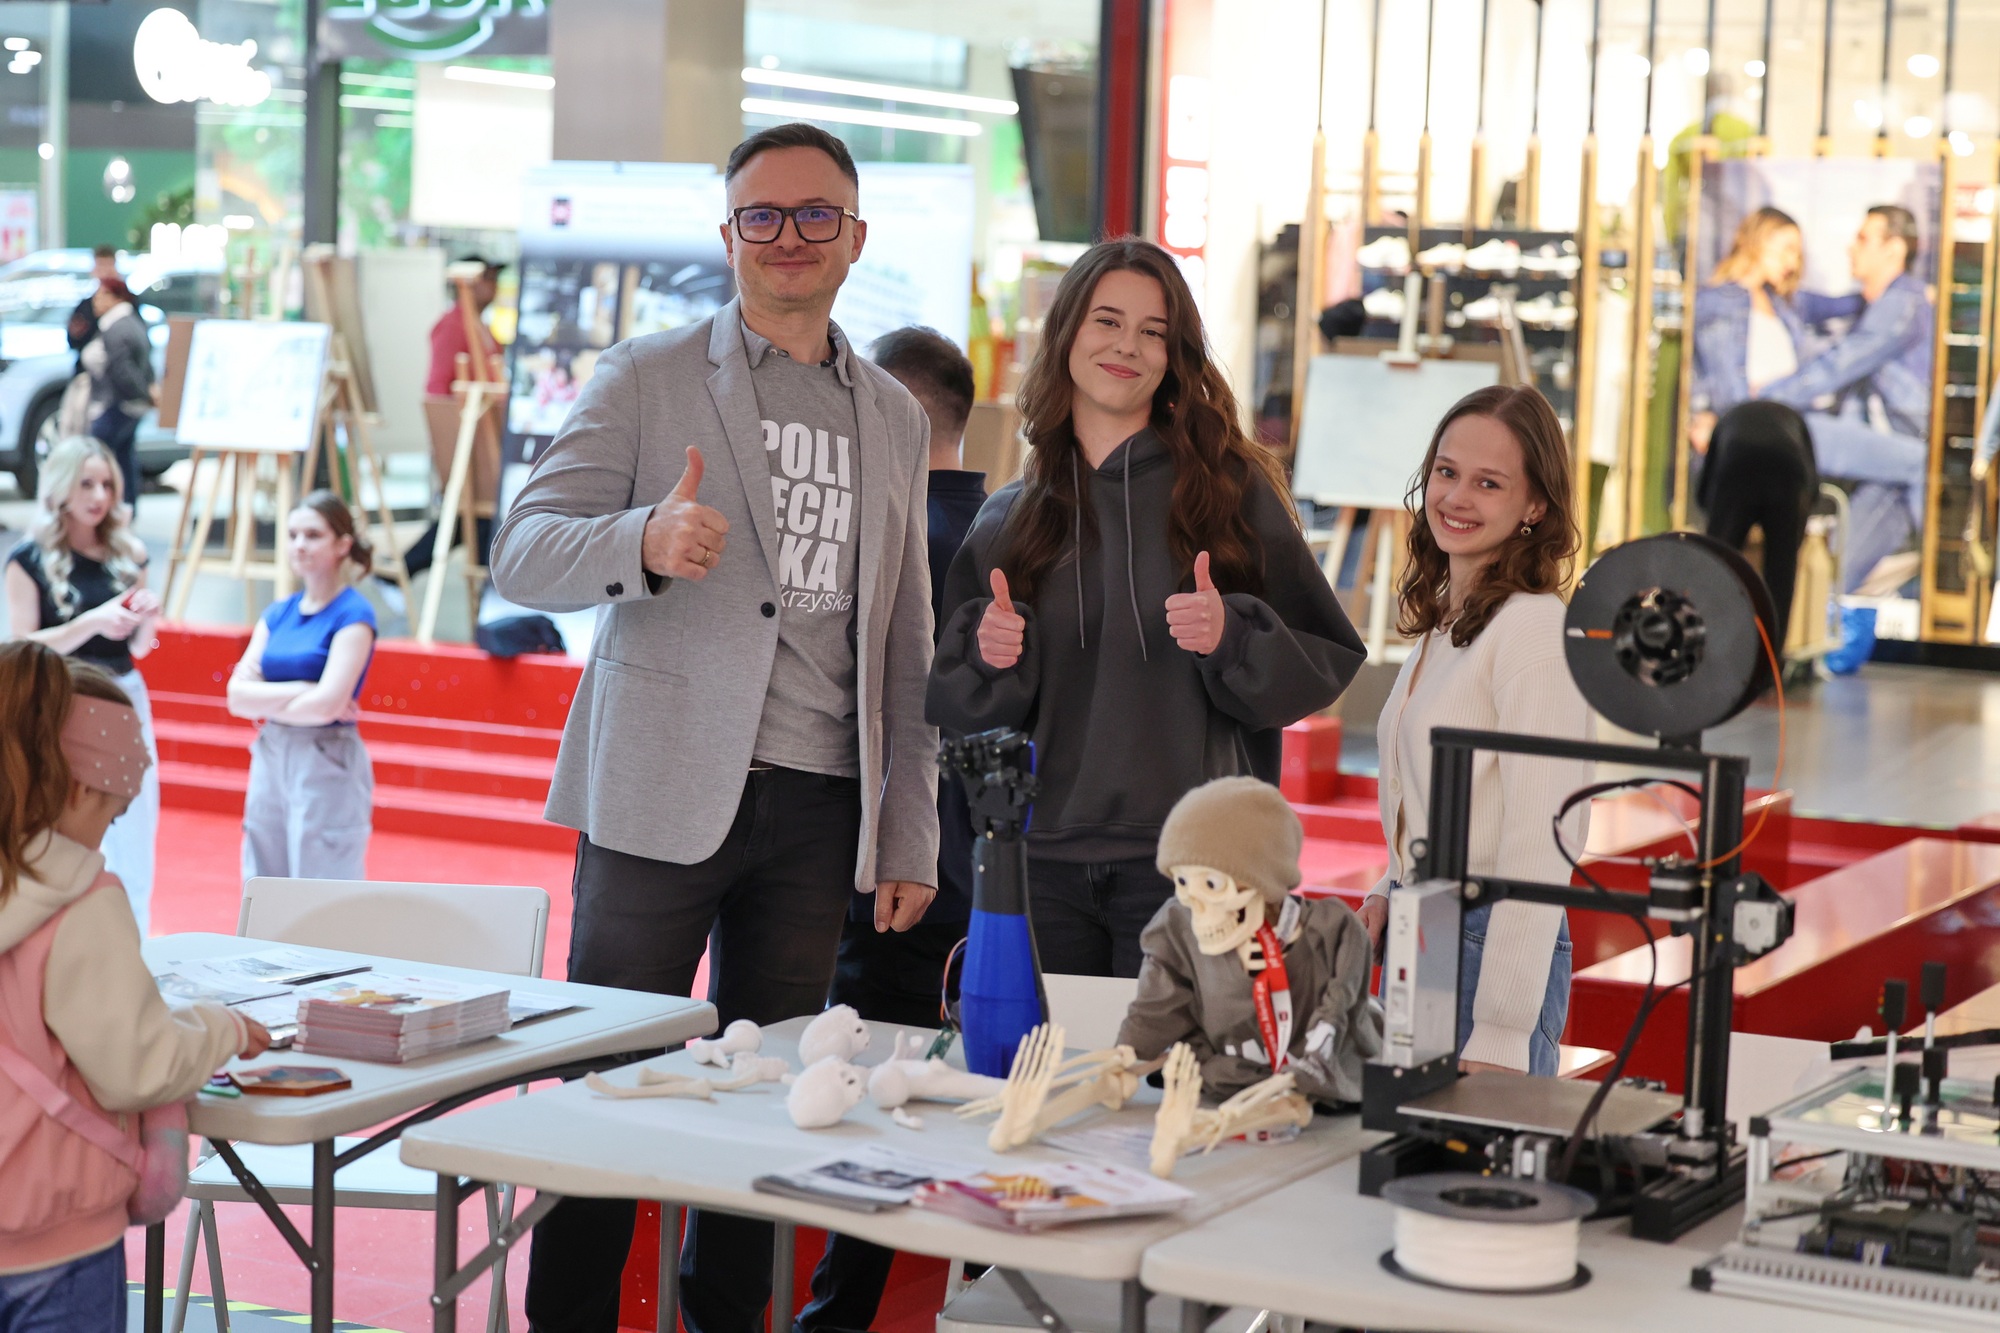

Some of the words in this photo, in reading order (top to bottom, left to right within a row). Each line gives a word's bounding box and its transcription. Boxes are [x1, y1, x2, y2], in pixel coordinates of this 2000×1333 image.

[761, 420, 850, 489] POLI
[771, 475, 853, 543] ECH
[777, 532, 840, 592] KA
